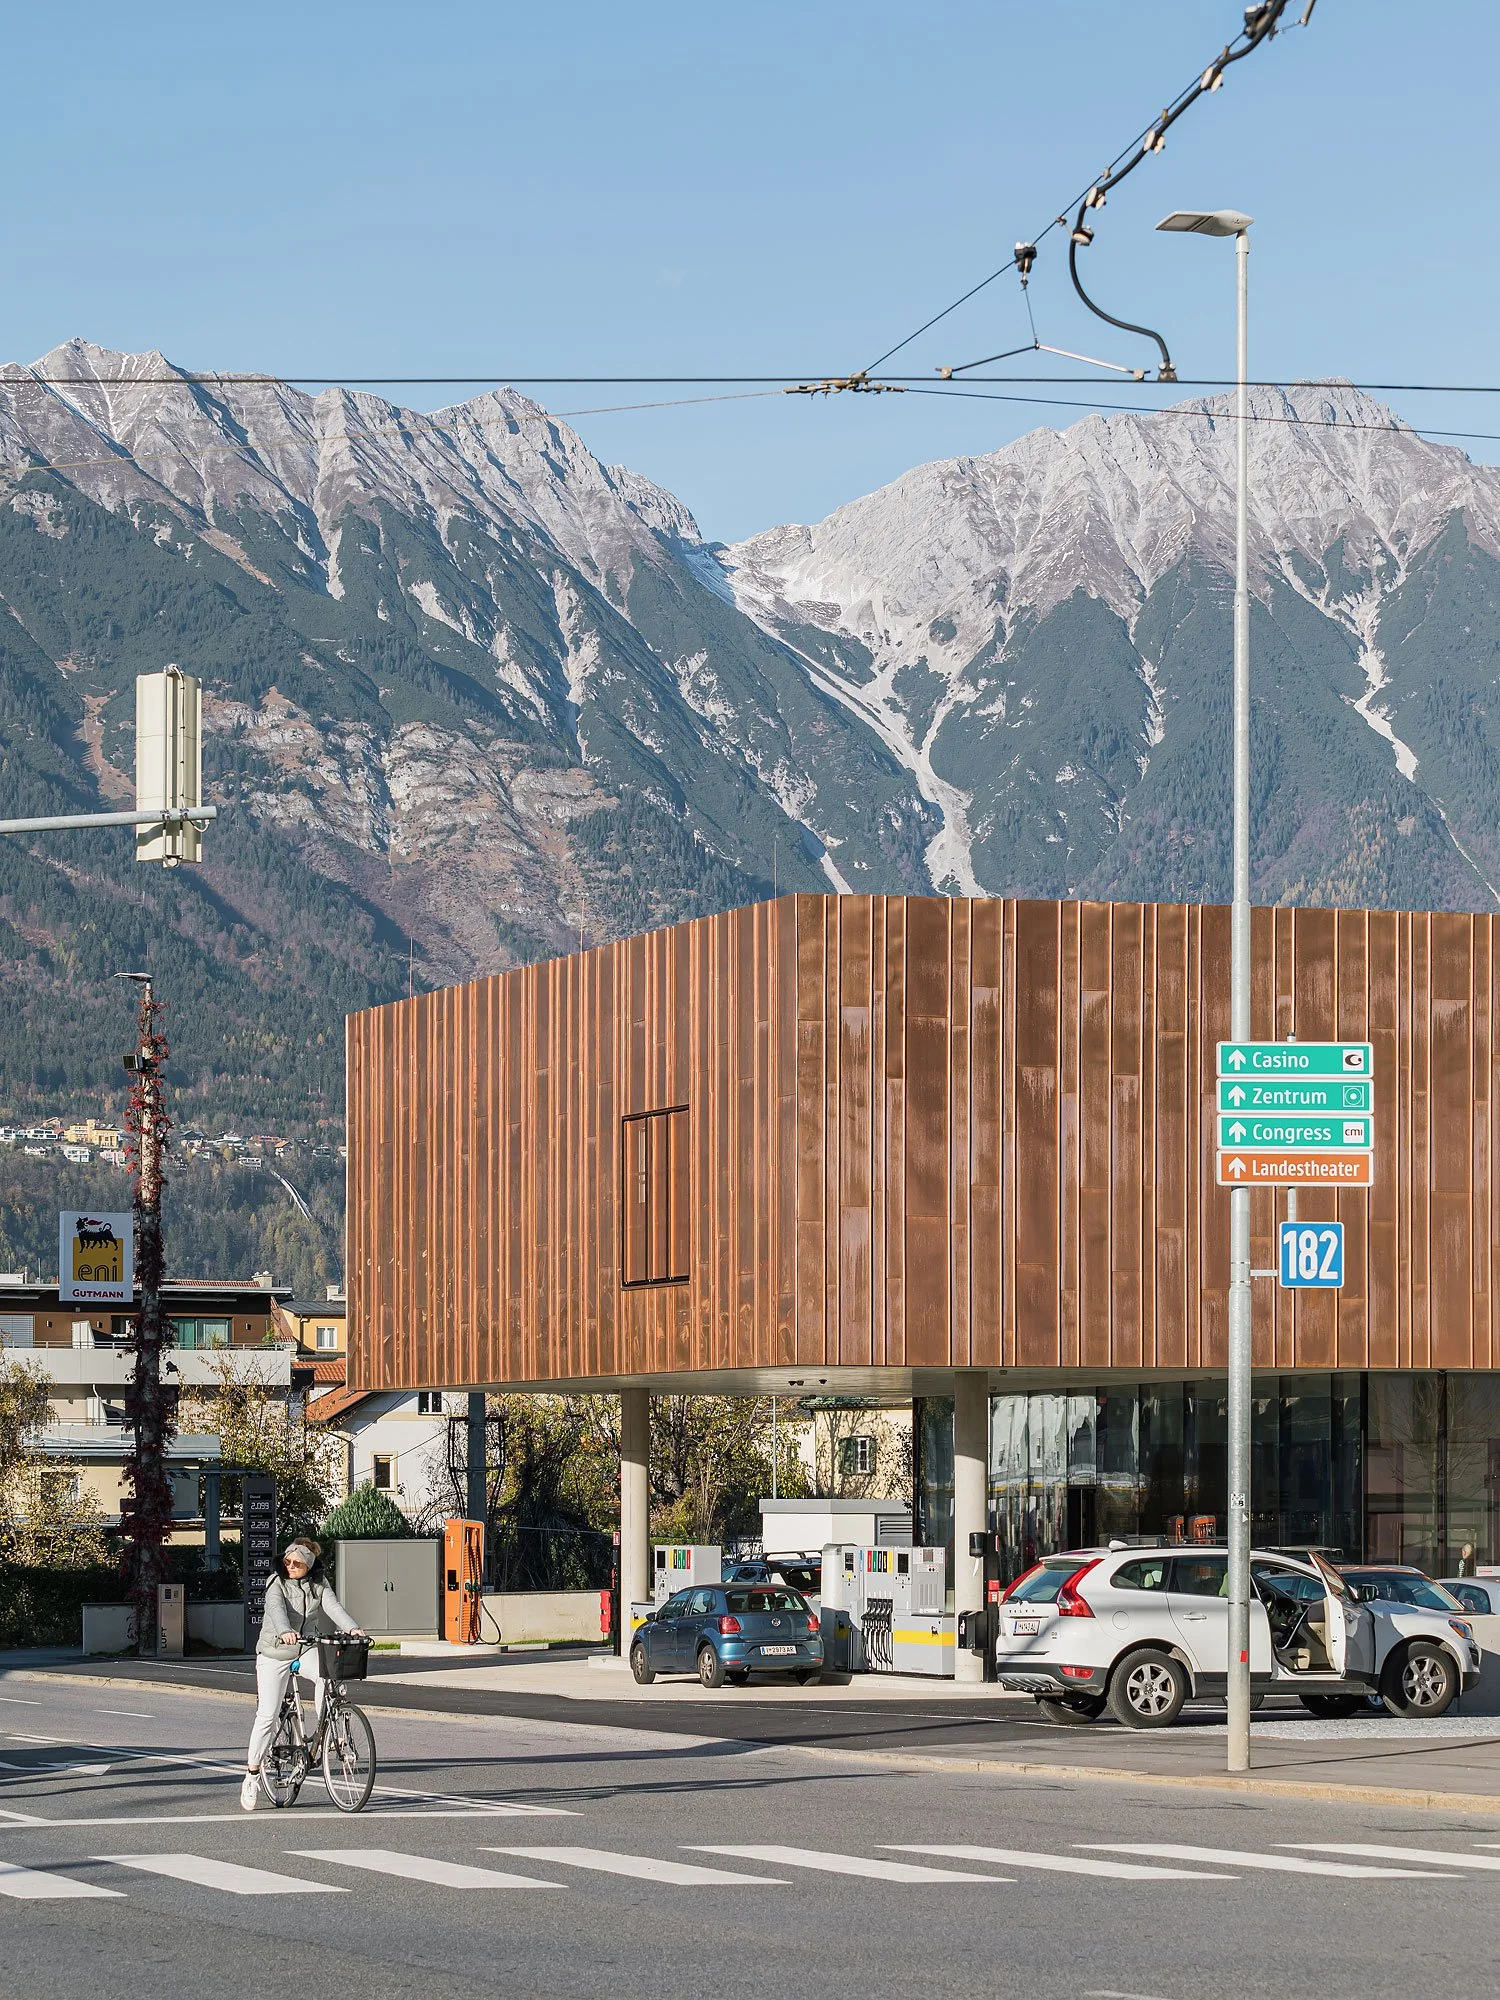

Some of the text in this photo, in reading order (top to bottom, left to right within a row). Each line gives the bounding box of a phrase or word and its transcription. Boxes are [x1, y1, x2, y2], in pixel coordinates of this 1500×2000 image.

[1252, 1051, 1309, 1068] Casino
[1252, 1088, 1327, 1104] Zentrum
[1252, 1124, 1332, 1143] Congress
[1252, 1159, 1360, 1177] Landestheater
[1283, 1230, 1339, 1279] 182
[78, 1257, 118, 1281] eni
[72, 1289, 124, 1298] GUTMANN
[250, 1502, 270, 1510] 2.099
[250, 1521, 270, 1529] 2.259
[250, 1540, 270, 1548] 2.259
[251, 1578, 267, 1586] 2.00
[253, 1597, 266, 1605] 1.69
